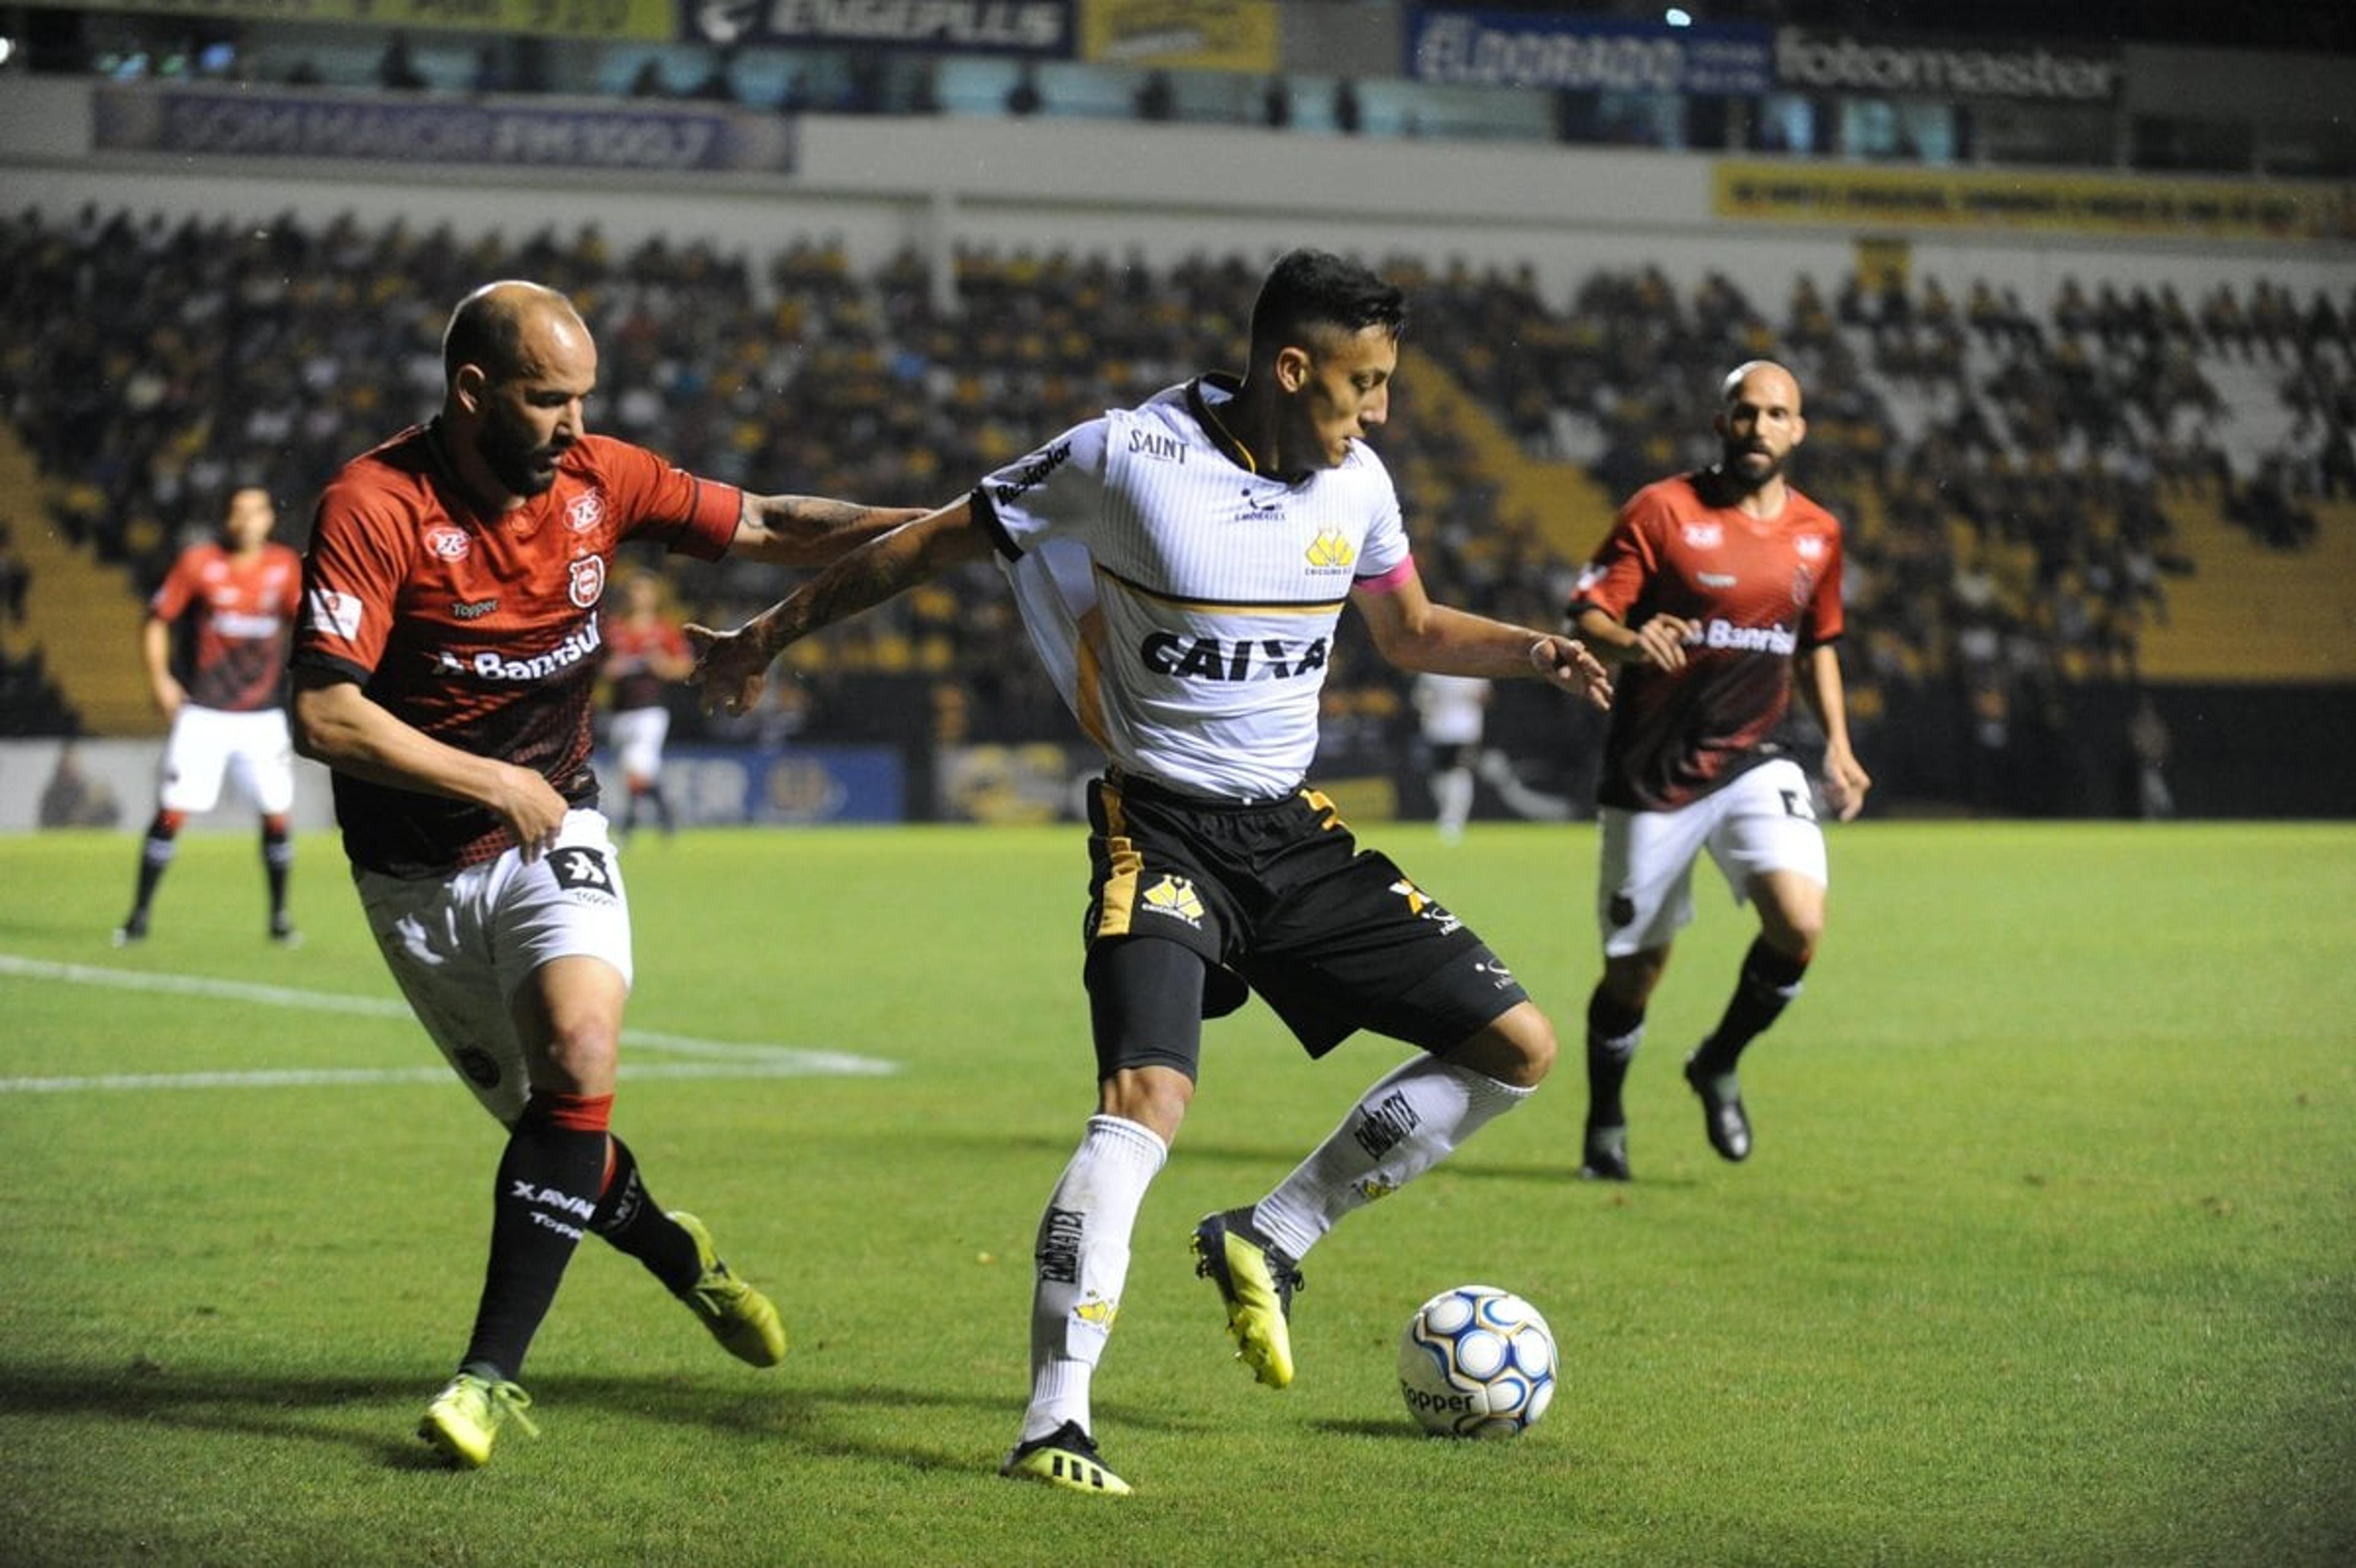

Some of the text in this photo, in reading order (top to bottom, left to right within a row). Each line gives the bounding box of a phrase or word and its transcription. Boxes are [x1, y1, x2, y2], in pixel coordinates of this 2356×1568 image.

[1416, 13, 1682, 91] ELDORADO
[1773, 27, 2114, 99] fotomaster
[1128, 429, 1189, 464] SAINT
[453, 600, 498, 619] Topper
[1141, 631, 1326, 682] CAIXA
